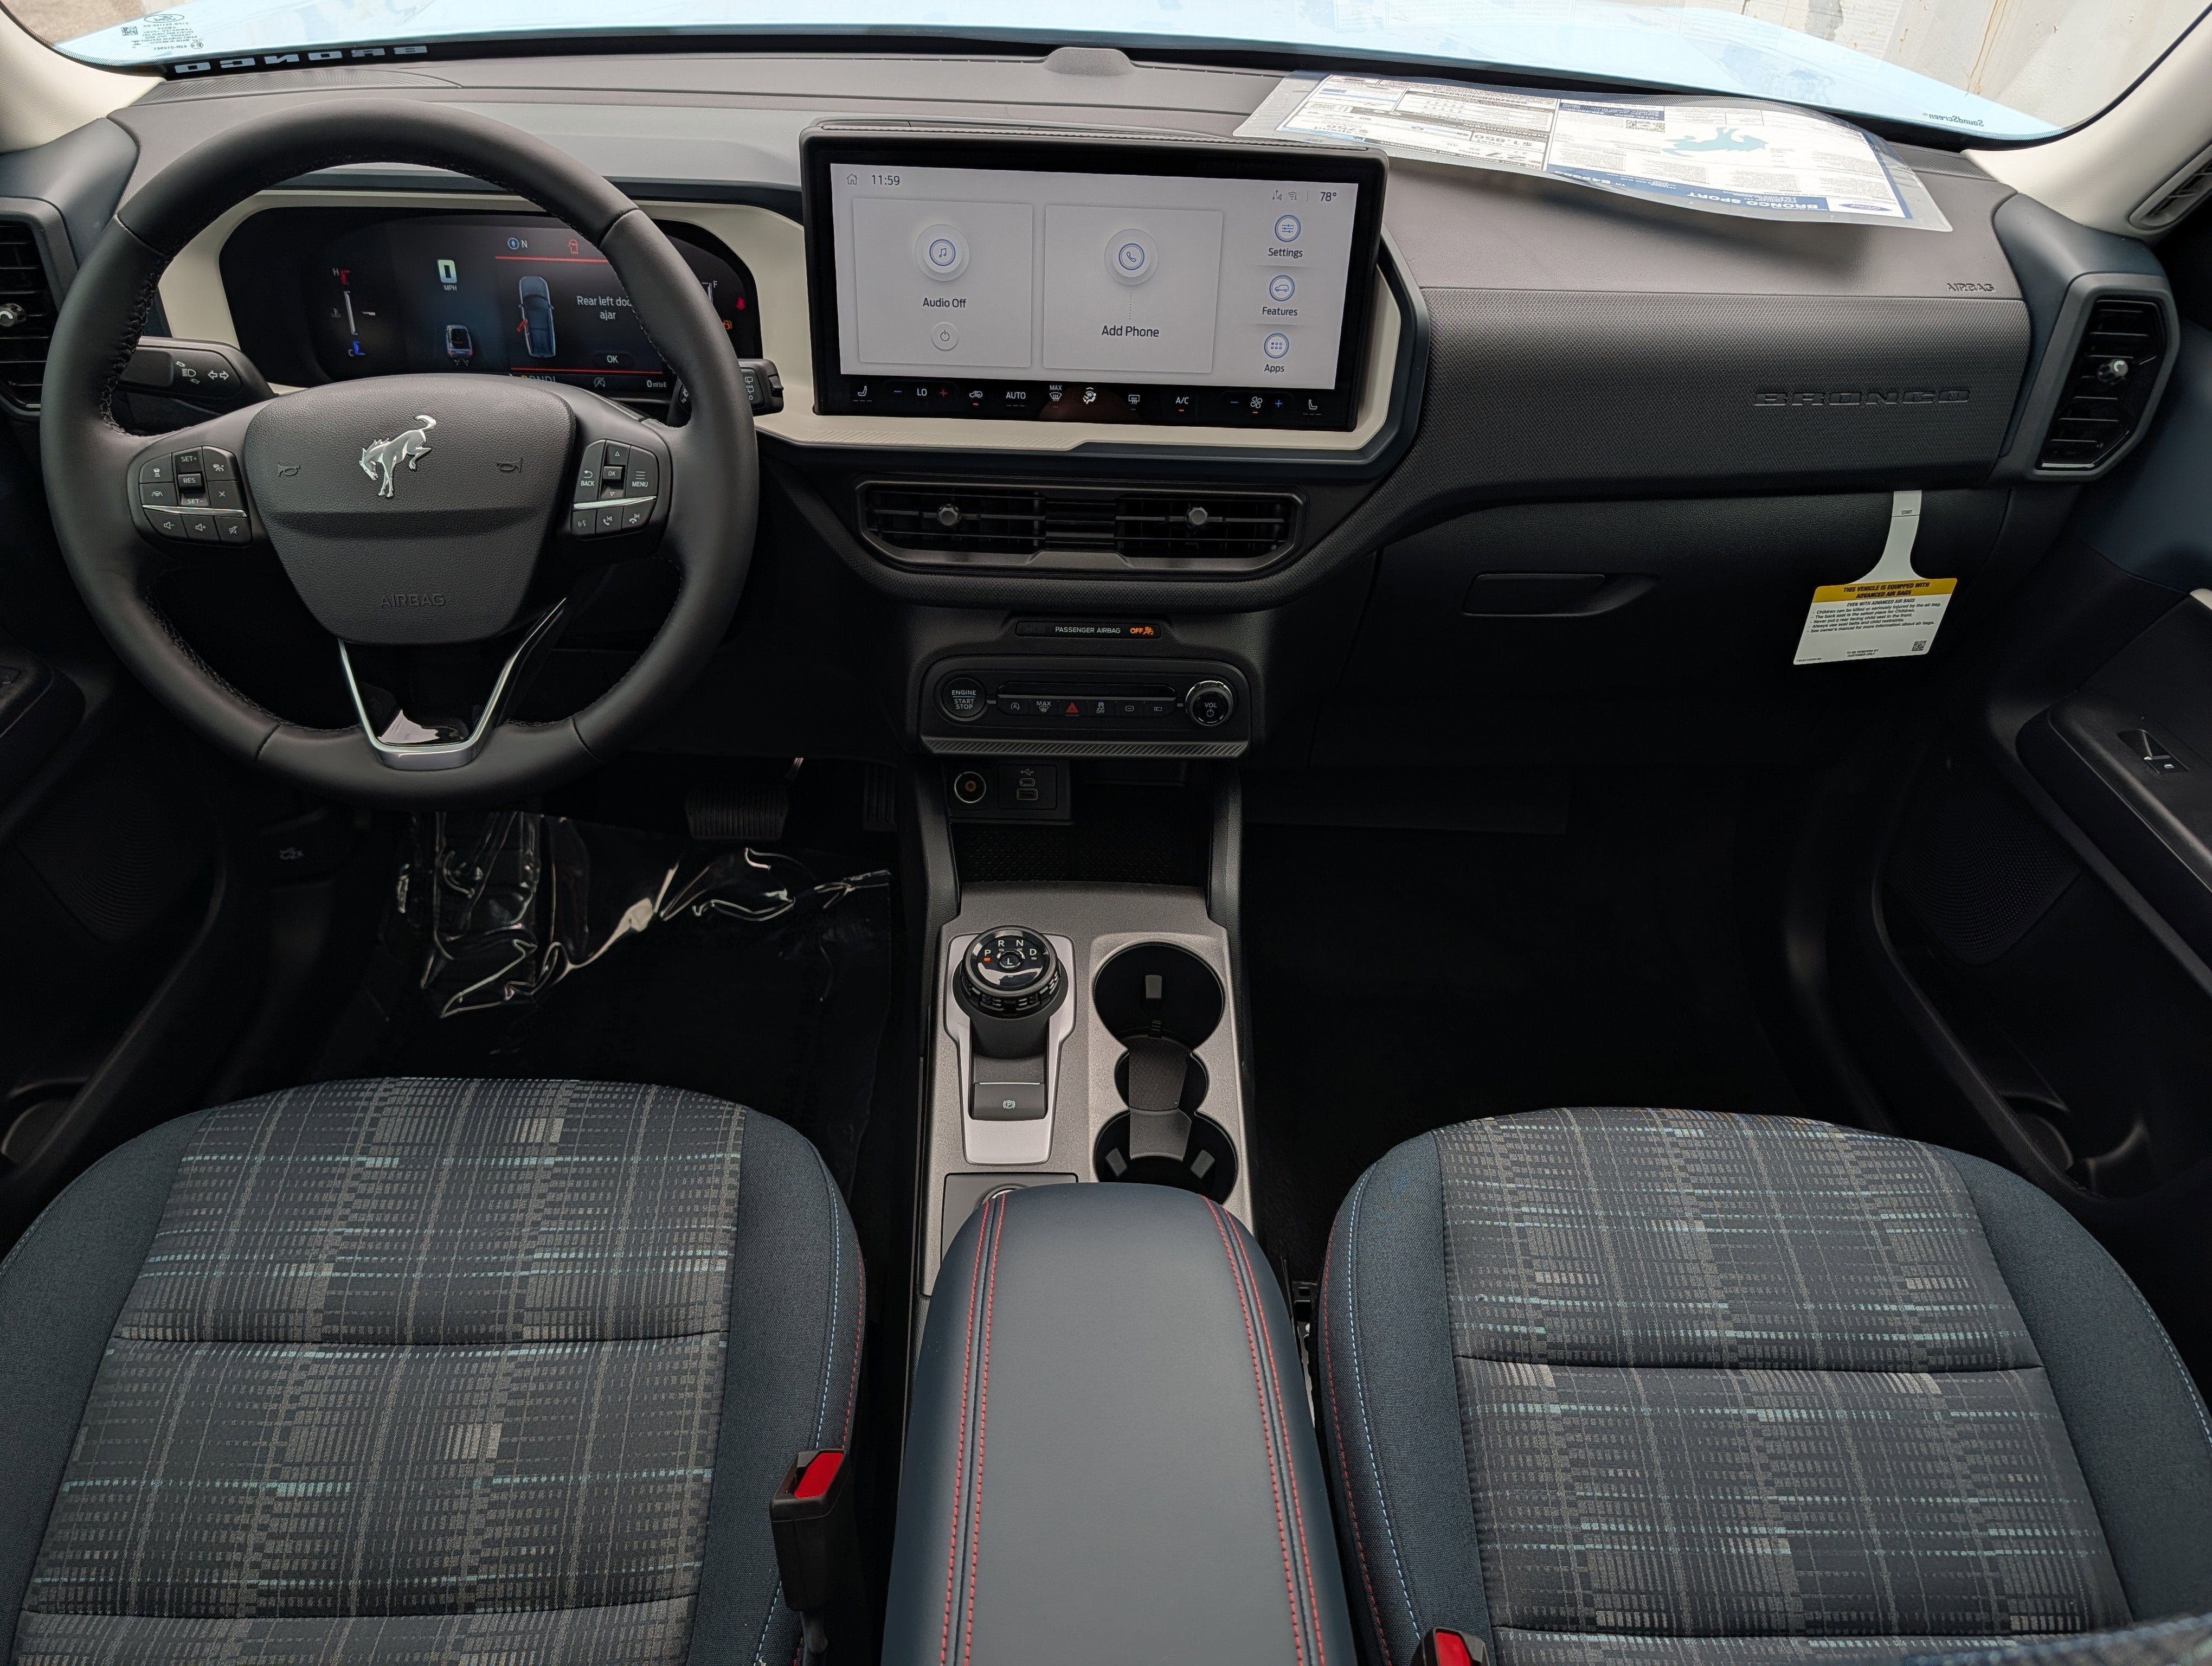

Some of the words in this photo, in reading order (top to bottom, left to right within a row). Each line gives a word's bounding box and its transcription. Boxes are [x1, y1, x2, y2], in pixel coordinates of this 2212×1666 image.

[871, 175, 900, 186] 11:59
[1687, 192, 1741, 204] SPORT
[1746, 200, 1818, 210] BRONCO
[522, 240, 528, 248] N
[1268, 247, 1303, 259] Settings
[1945, 282, 1995, 292] AIRBAG
[577, 296, 597, 305] Rear
[599, 296, 614, 306] left
[616, 296, 632, 306] doo
[923, 297, 951, 308] Audio
[951, 298, 967, 309] Off
[599, 311, 616, 321] ajar
[1262, 306, 1298, 317] Features
[1102, 325, 1123, 337] Add
[1125, 325, 1160, 338] Phone
[606, 355, 619, 363] OK
[1264, 364, 1285, 374] Apps
[917, 388, 927, 396] LO
[1006, 391, 1026, 400] AUTO
[1175, 396, 1189, 405] A/C
[1754, 390, 1971, 407] BRONCO
[381, 593, 445, 607] AIRBAG
